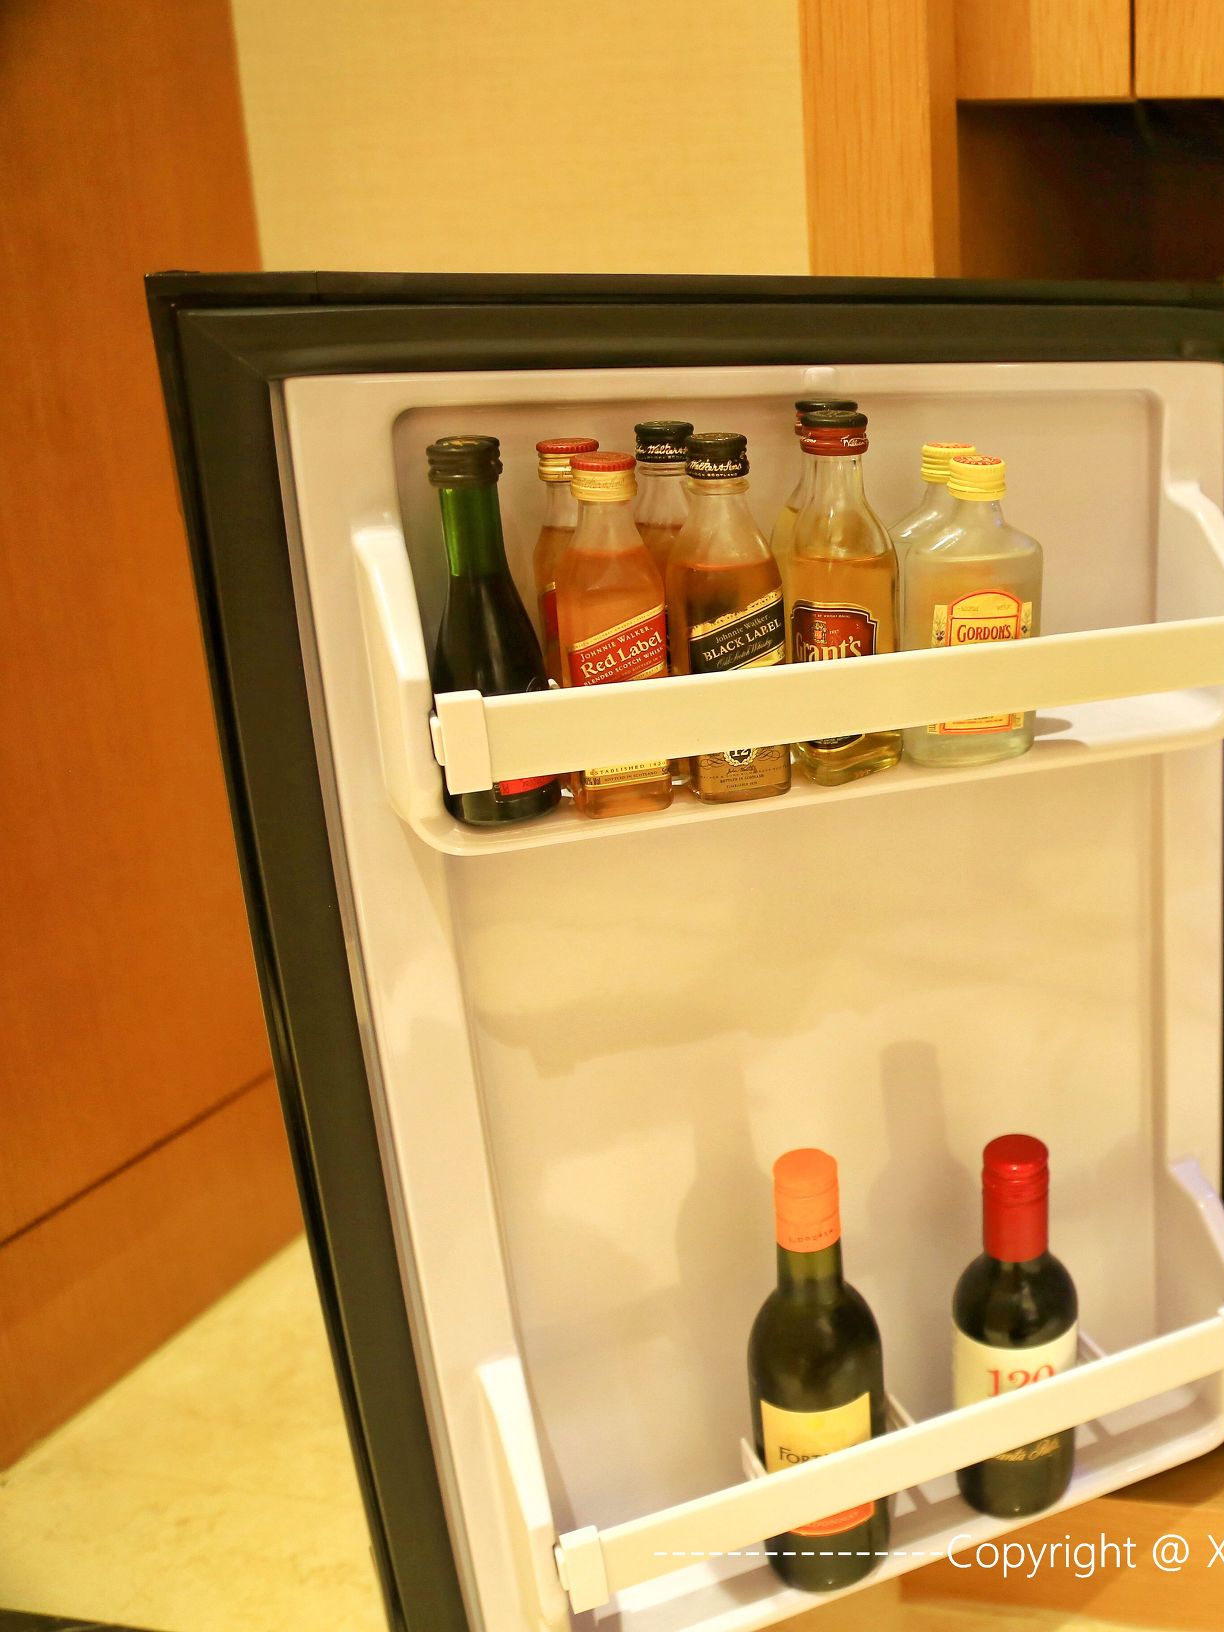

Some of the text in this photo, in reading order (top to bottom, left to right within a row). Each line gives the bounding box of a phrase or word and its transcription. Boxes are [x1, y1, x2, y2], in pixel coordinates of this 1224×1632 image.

[716, 627, 743, 644] Johnnie
[957, 624, 1012, 643] GORDON'S
[580, 641, 617, 662] JOHNNIE
[580, 631, 662, 679] Red Label
[702, 636, 745, 661] BLACK
[796, 632, 862, 662] Grant's
[615, 657, 641, 673] SCOTCH
